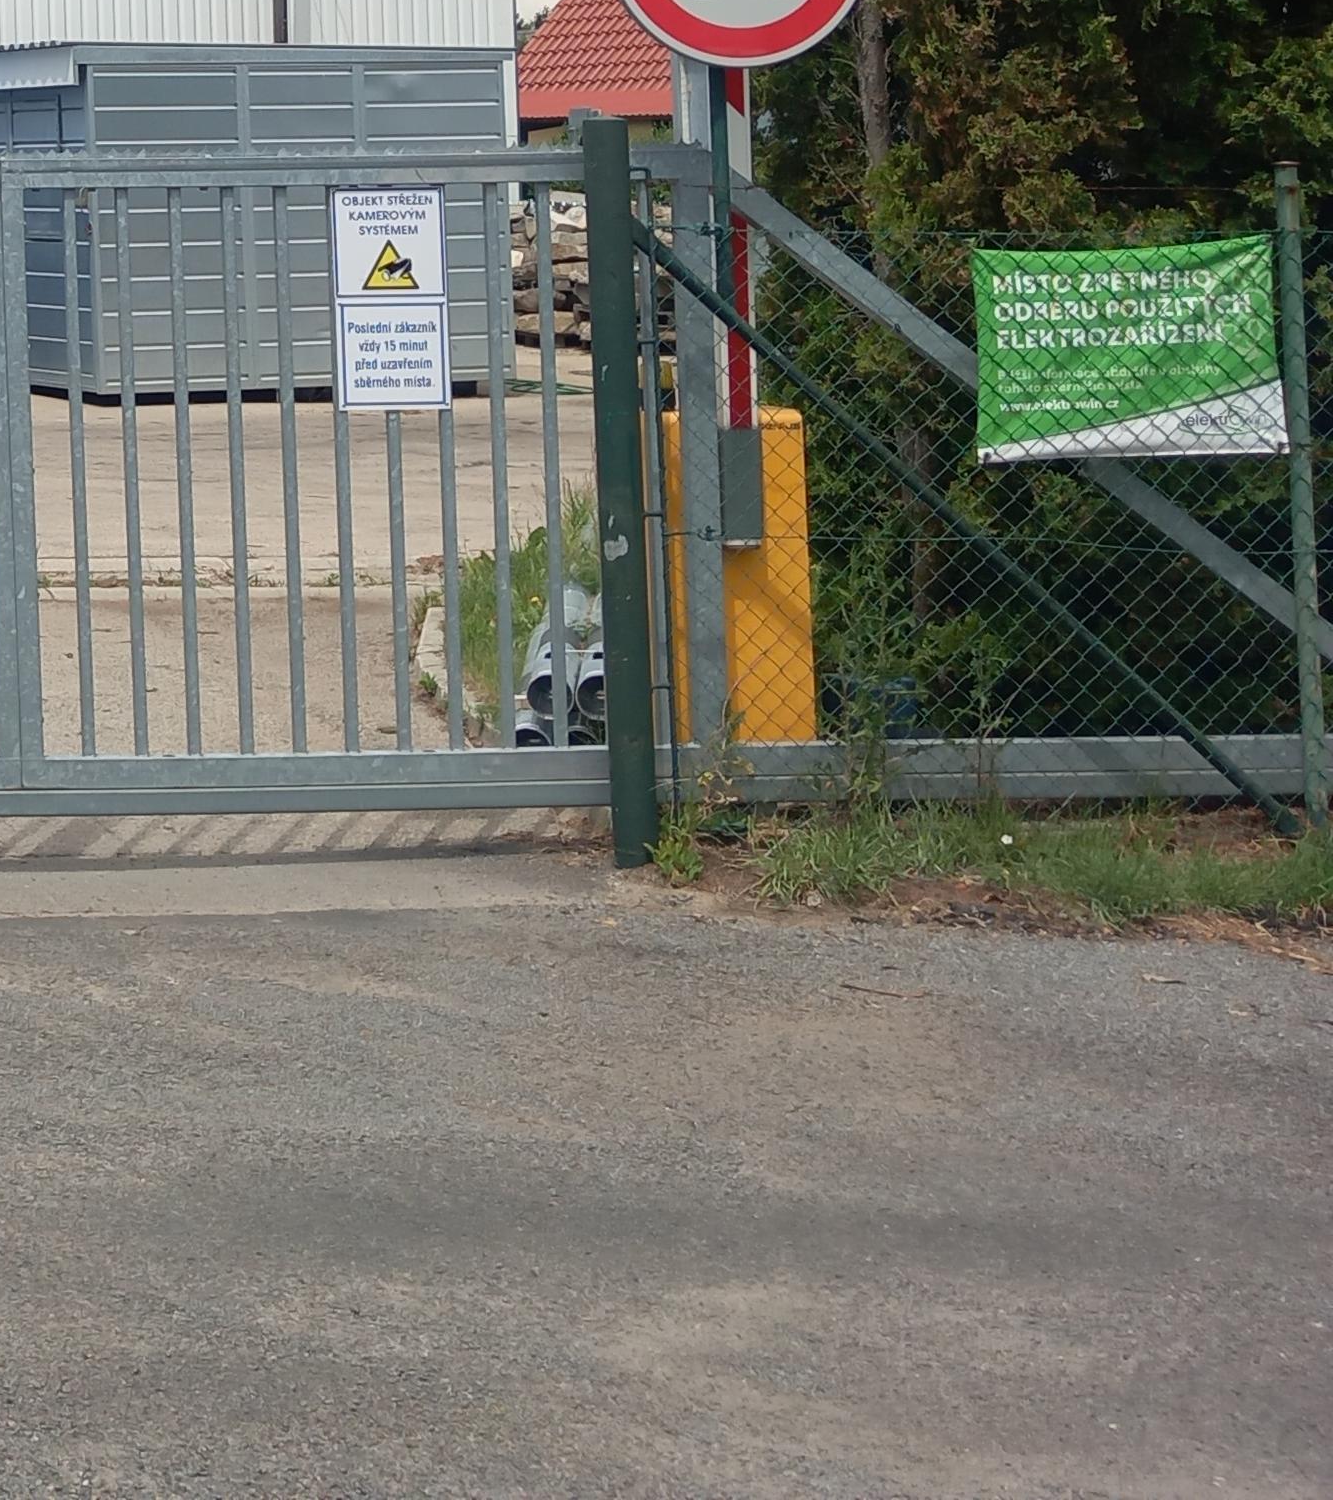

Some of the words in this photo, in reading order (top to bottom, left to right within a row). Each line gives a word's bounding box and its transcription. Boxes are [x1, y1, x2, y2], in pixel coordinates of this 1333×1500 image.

[341, 196, 383, 207] OBJEKT
[387, 194, 433, 206] STŘEŽEN
[348, 208, 426, 221] KAMEROVÝM
[359, 222, 419, 236] SYSTÉMEM
[992, 270, 1073, 295] MÍSTO
[994, 296, 1098, 322] ODBĚRU
[348, 321, 392, 334] Poslední
[394, 320, 437, 333] zákazník
[358, 340, 380, 353] vždy
[384, 340, 396, 351] 15
[399, 340, 428, 351] minut
[355, 357, 378, 372] před
[381, 357, 433, 370] uzavřením
[354, 376, 401, 388] sběrného
